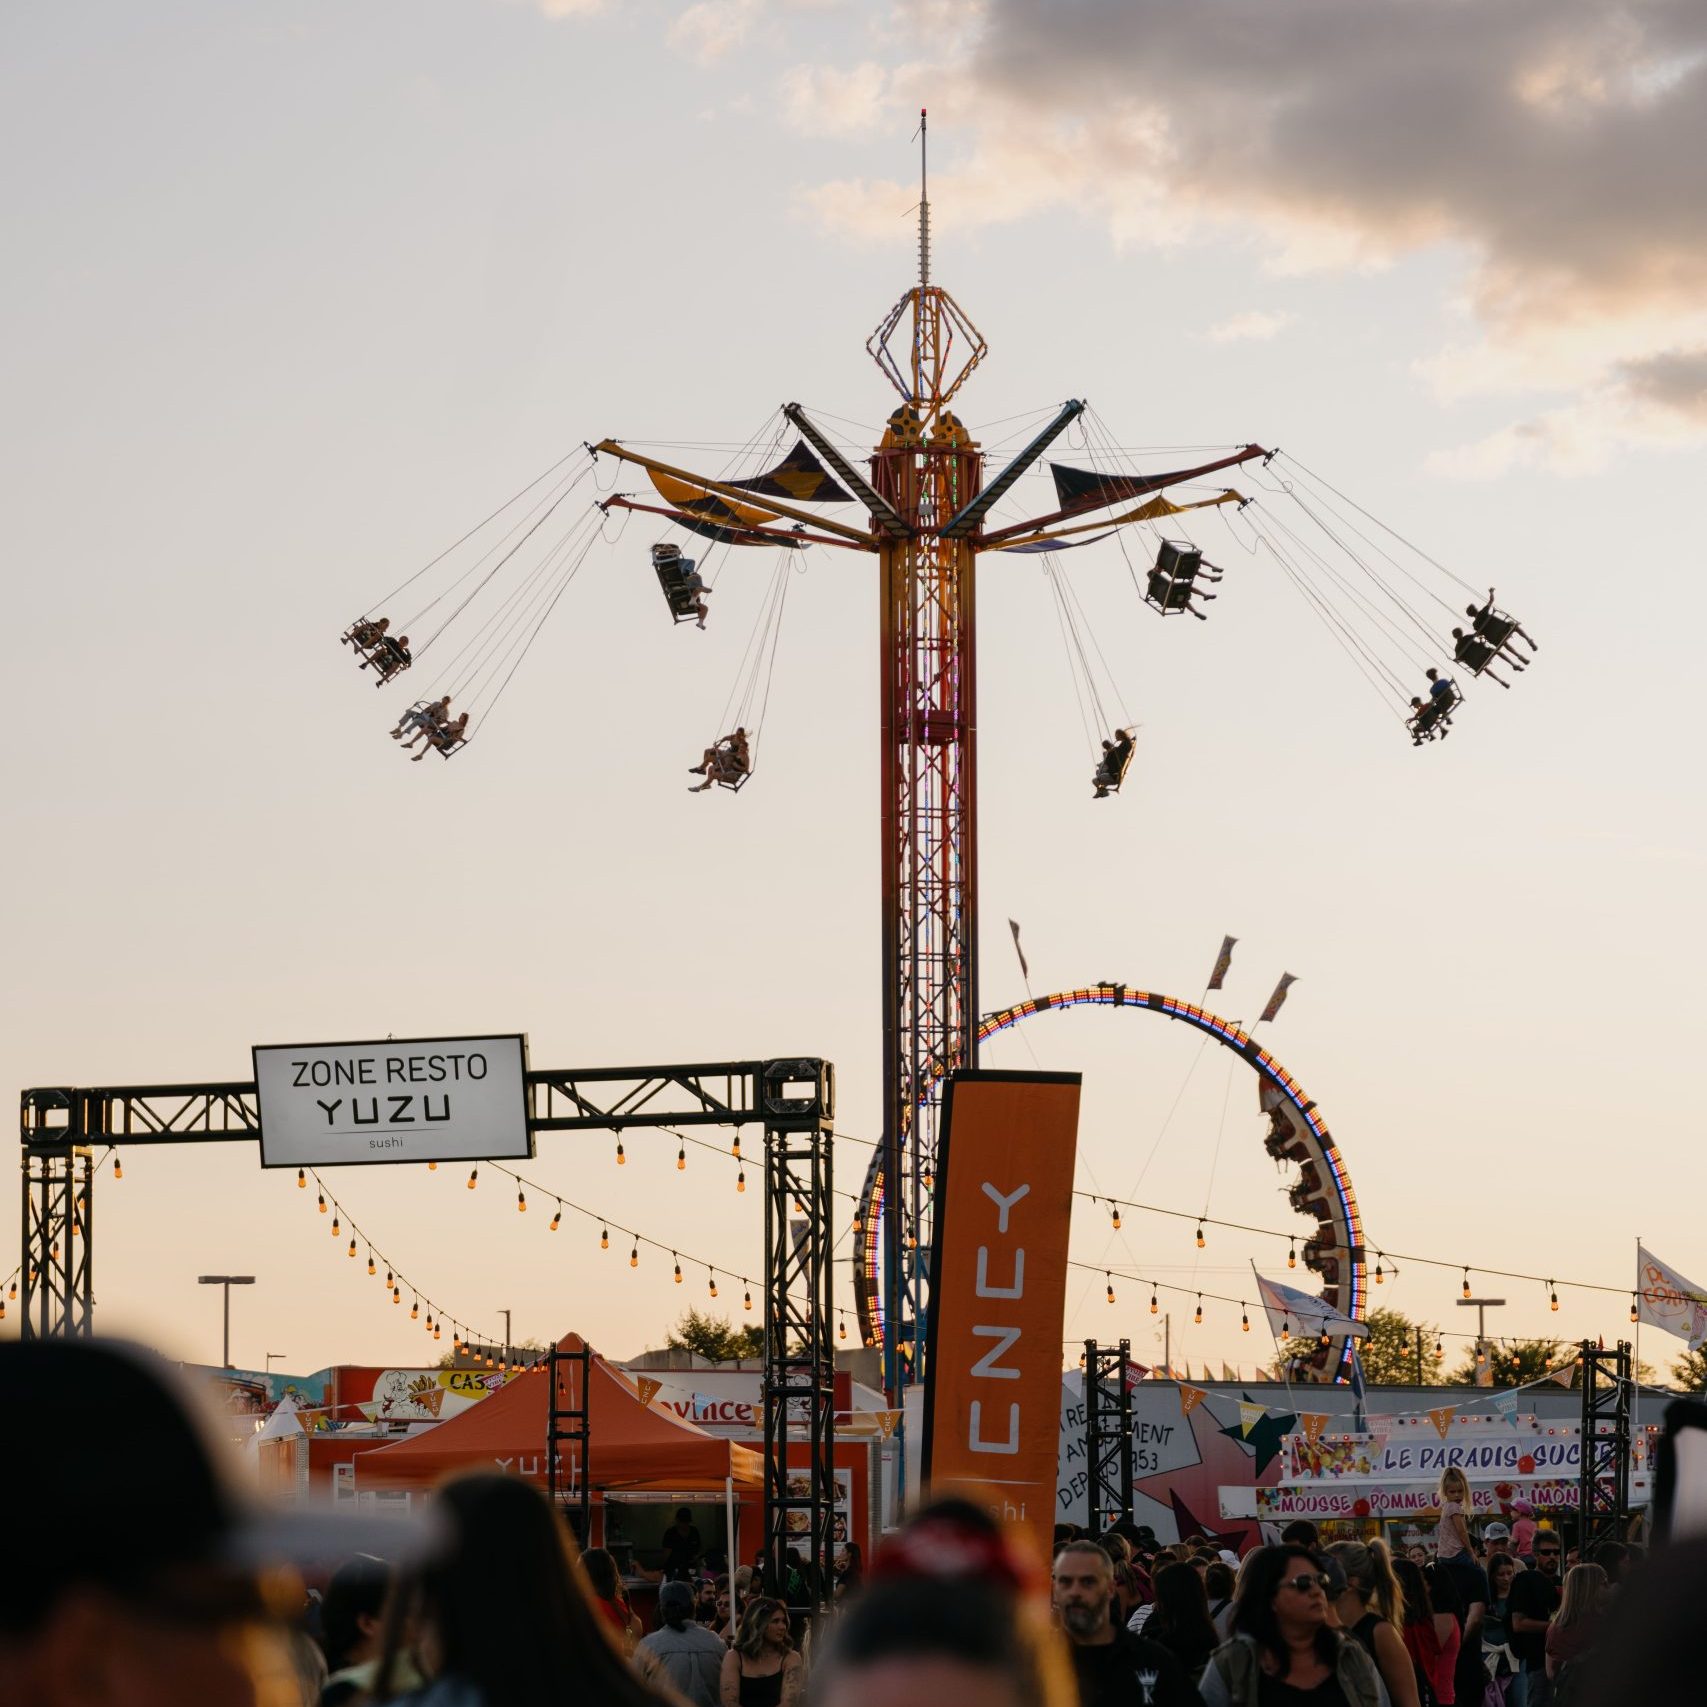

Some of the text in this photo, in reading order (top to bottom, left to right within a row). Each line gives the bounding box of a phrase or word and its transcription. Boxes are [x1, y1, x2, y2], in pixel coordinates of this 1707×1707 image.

[291, 1053, 488, 1087] ZONE RESTO
[316, 1094, 451, 1125] YUZU
[369, 1136, 403, 1149] sushi
[968, 1181, 1031, 1455] YUZU
[1131, 1449, 1158, 1473] 953
[1384, 1448, 1412, 1470] LE
[1419, 1445, 1517, 1469] PARADIS
[1281, 1495, 1351, 1513] MOUSSE
[1370, 1491, 1427, 1509] POMME
